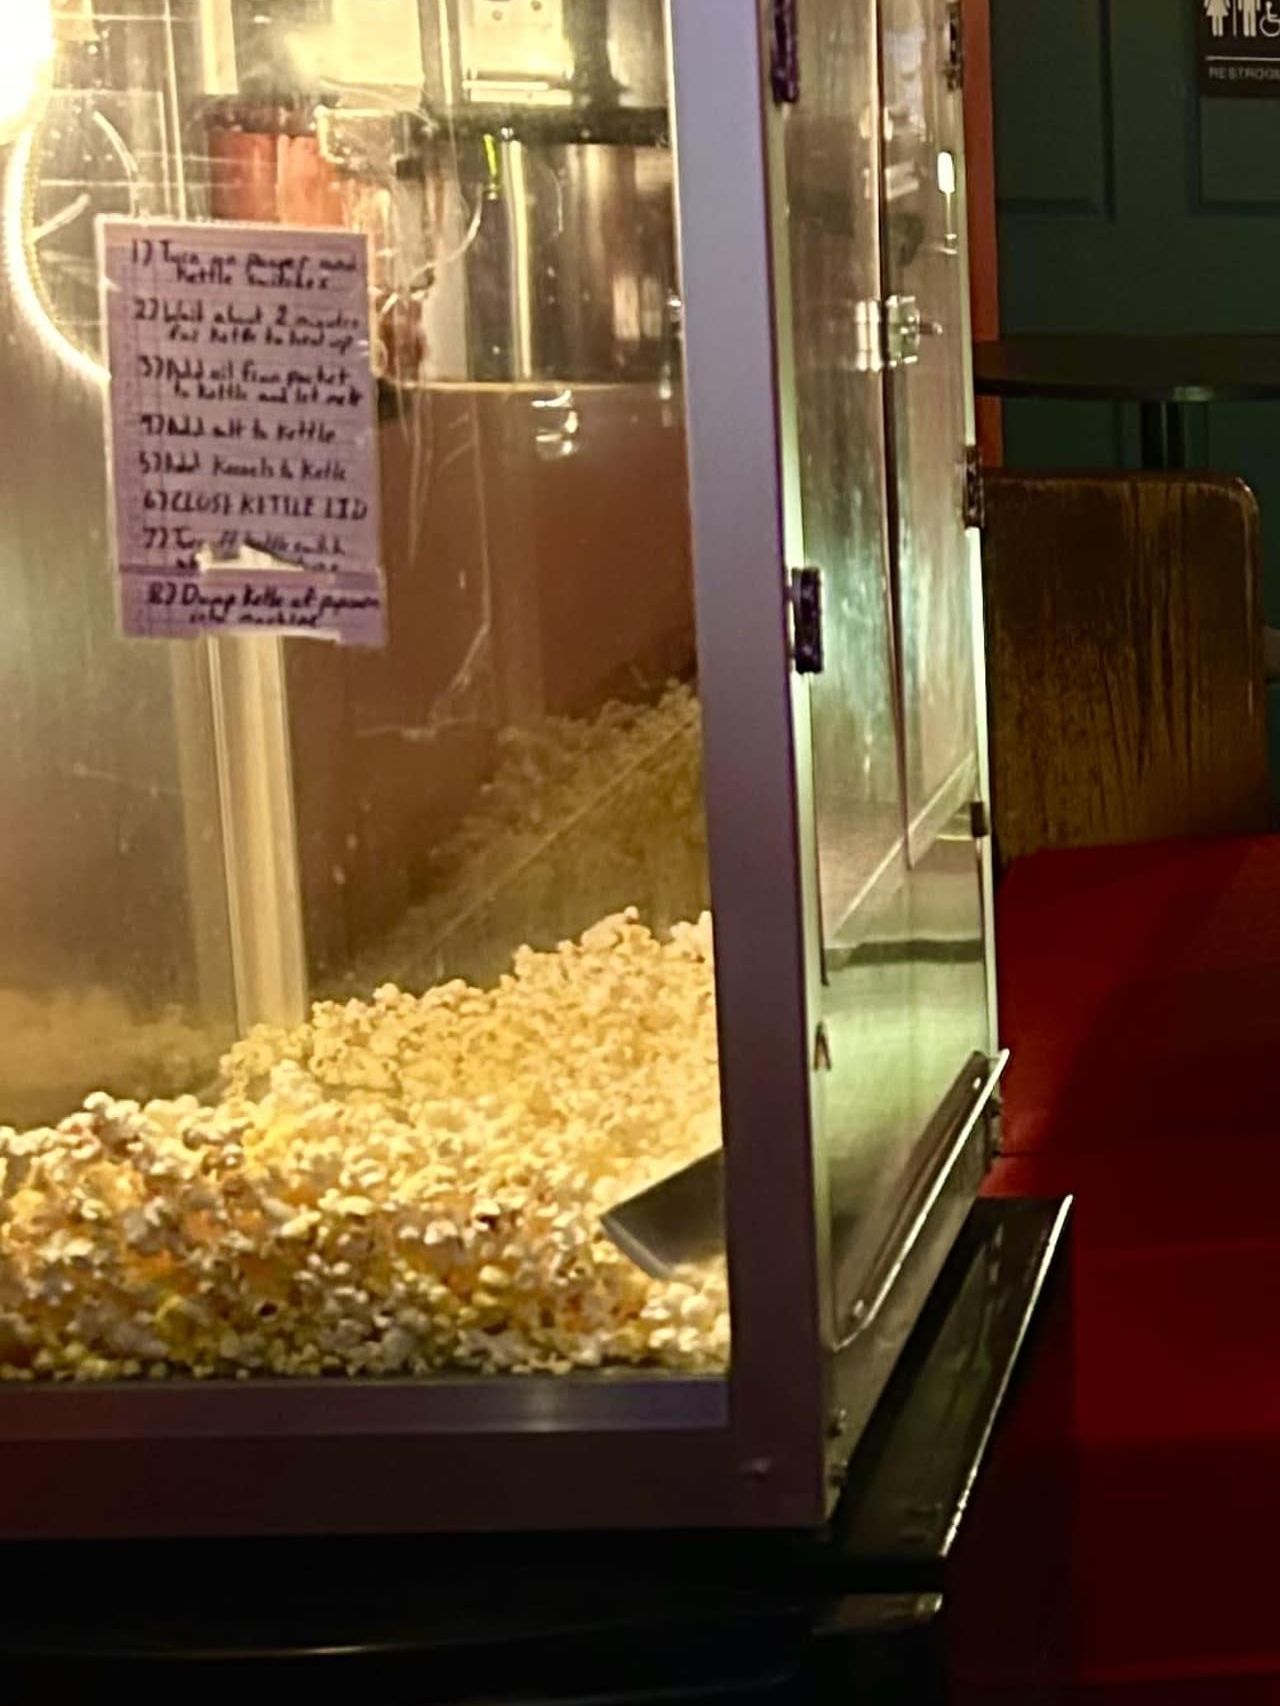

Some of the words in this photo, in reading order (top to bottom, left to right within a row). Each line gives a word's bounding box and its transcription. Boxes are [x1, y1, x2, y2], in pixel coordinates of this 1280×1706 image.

[132, 240, 154, 267] 1)
[132, 296, 161, 322] 2)
[274, 304, 290, 327] 2
[137, 355, 165, 379] 3)
[138, 451, 162, 475] 5)
[143, 490, 168, 512] 6)
[240, 492, 316, 517] KETTLE
[323, 496, 369, 521] LID
